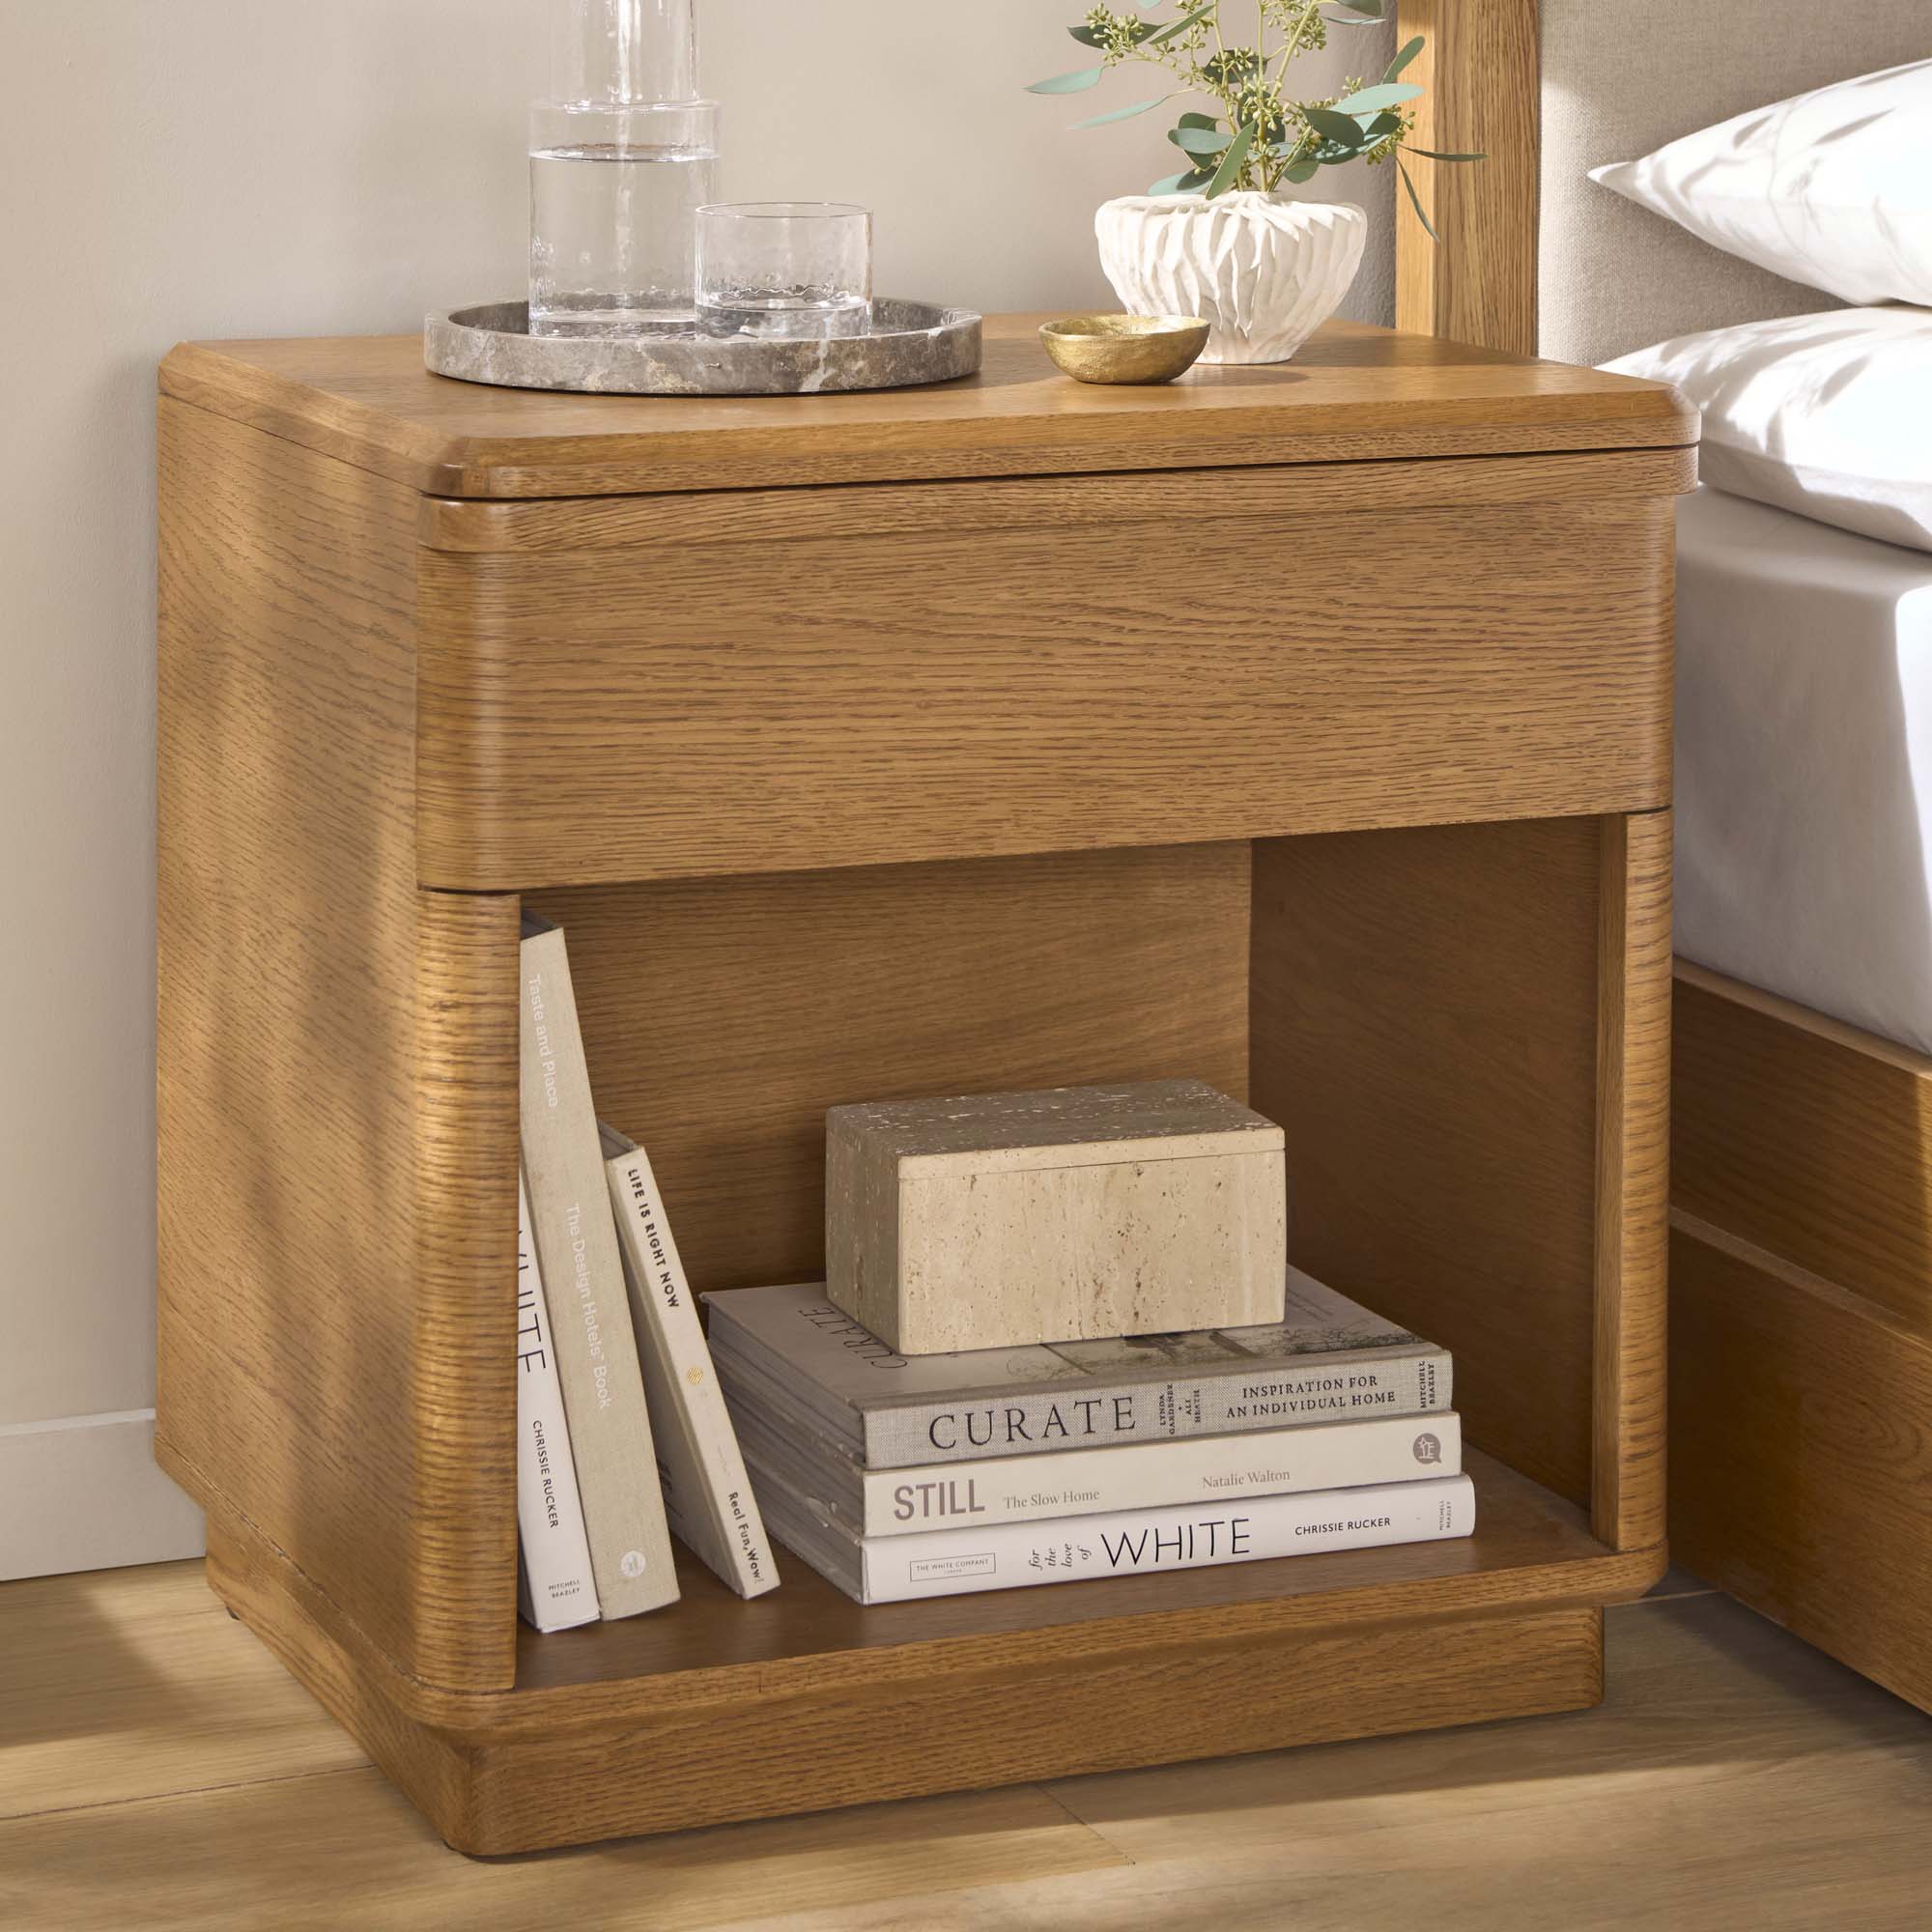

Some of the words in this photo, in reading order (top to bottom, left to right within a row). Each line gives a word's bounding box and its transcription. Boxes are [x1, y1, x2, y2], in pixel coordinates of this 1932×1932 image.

[528, 974, 544, 1021] Taste
[536, 1025, 554, 1057] and
[542, 1061, 558, 1107] Place
[565, 1202, 580, 1236] The
[628, 1169, 644, 1198] LIFE
[639, 1203, 651, 1218] IS
[645, 1222, 667, 1266] RIGHT
[660, 1271, 679, 1307] NOW
[572, 1238, 591, 1299] Design
[593, 1365, 612, 1409] Book
[1242, 1378, 1344, 1399] INSPIRATION
[1350, 1376, 1378, 1389] FOR
[1418, 1360, 1427, 1408] MITCHELL
[1167, 1383, 1176, 1435] GARDENER
[1227, 1406, 1247, 1418] AN
[1253, 1396, 1347, 1415] INDIVIDUAL
[1351, 1391, 1396, 1406] HOME
[928, 1397, 1136, 1450] CURATE
[532, 1420, 551, 1475] CHRISSIE
[543, 1478, 558, 1528] RUCKER
[1202, 1473, 1244, 1489] Natalie
[1247, 1469, 1291, 1484] Walton
[894, 1479, 985, 1521] STILL
[1004, 1495, 1028, 1509] The
[1031, 1492, 1060, 1507] Slow
[1063, 1489, 1100, 1504] Home
[728, 1492, 746, 1520] Real
[738, 1523, 751, 1550] Fun,
[1294, 1521, 1344, 1536] CHRISSIE
[1348, 1517, 1391, 1530] RUCKER
[1028, 1549, 1042, 1571] for
[1047, 1548, 1057, 1567] the
[1061, 1543, 1072, 1568] love
[1077, 1545, 1092, 1561] of
[1100, 1519, 1250, 1568] WHITE
[932, 1561, 952, 1570] WHITE
[552, 1587, 581, 1598] BEAZLEY
